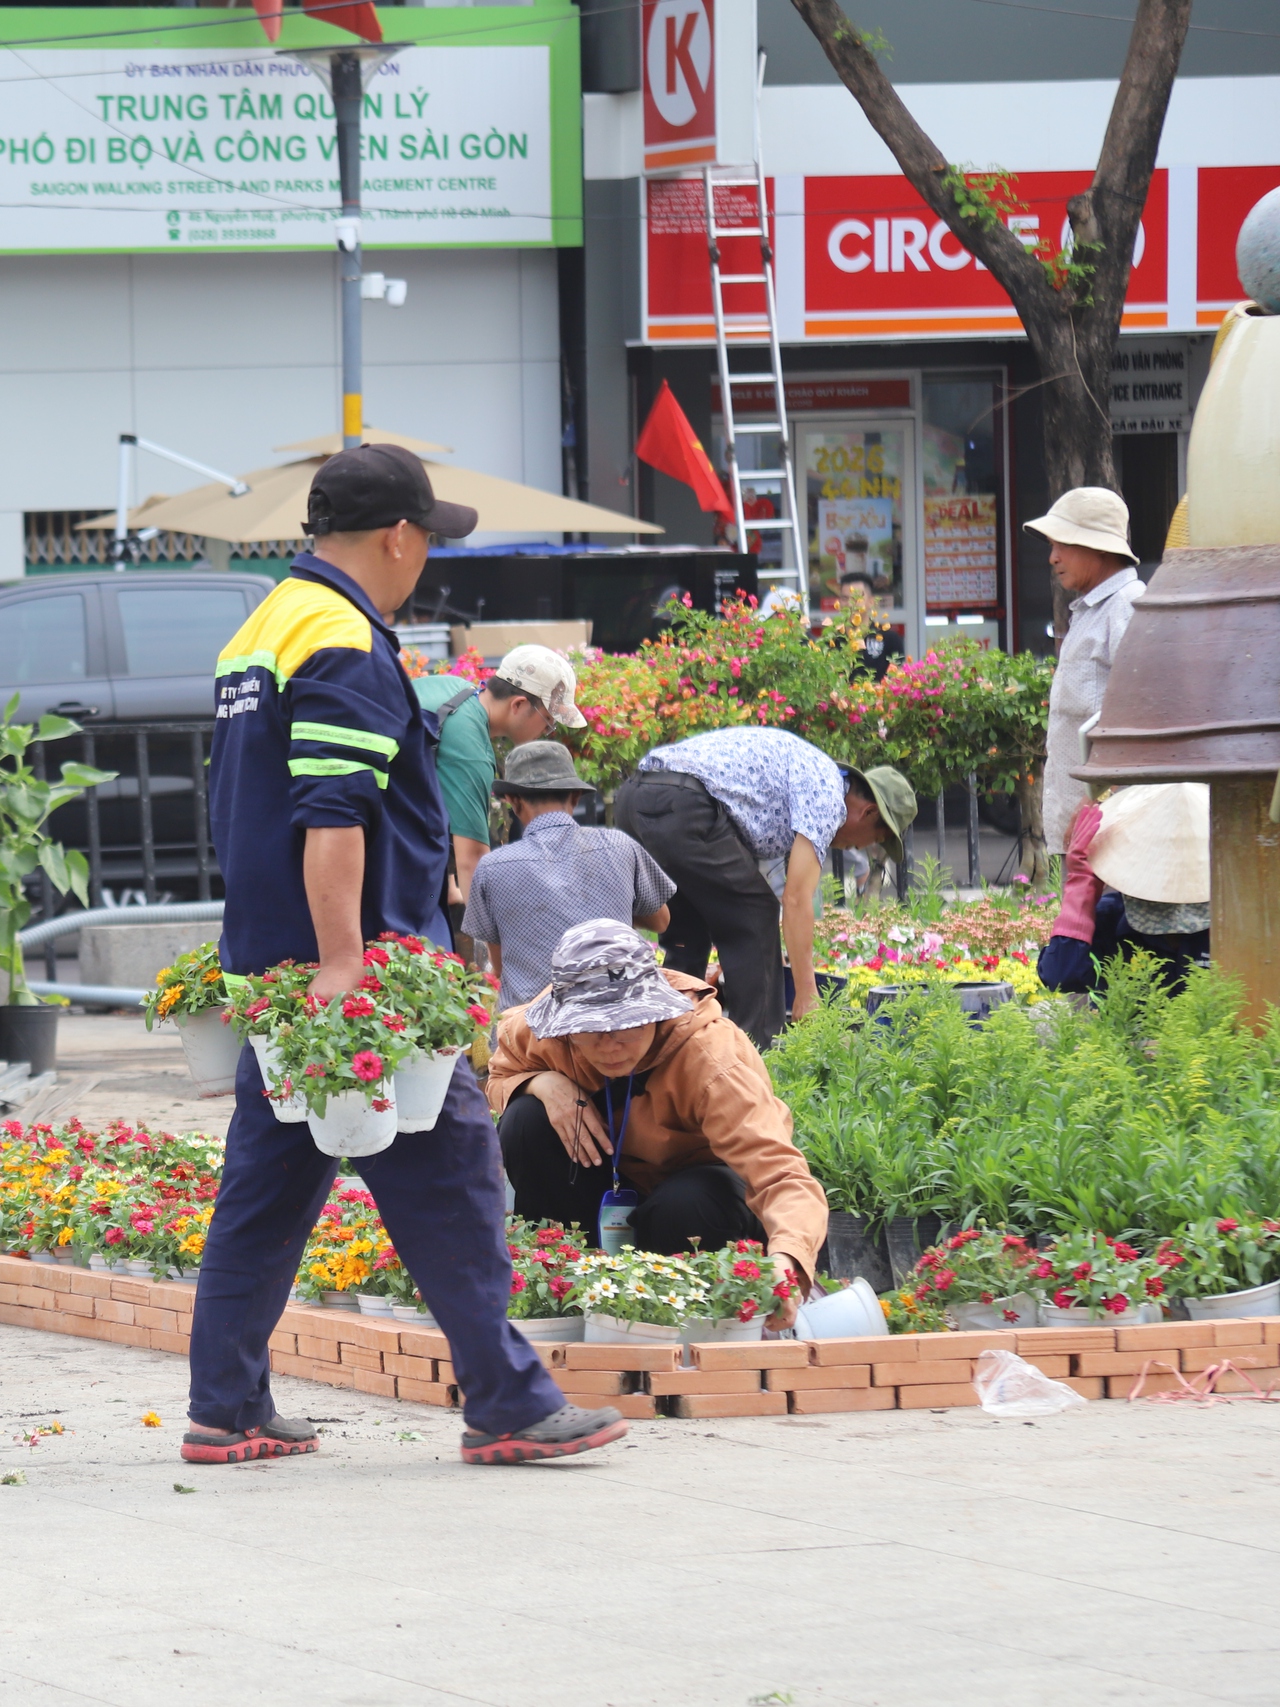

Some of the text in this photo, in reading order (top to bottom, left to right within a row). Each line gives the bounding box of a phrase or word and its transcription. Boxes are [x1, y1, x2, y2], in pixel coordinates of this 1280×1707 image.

[151, 65, 181, 77] BAN
[234, 61, 264, 76] DÂN
[97, 86, 430, 121] TRUNG TÂM QUN LÝ
[65, 137, 95, 163] ĐI
[108, 134, 153, 170] BỘ
[162, 130, 204, 162] VÀ
[215, 129, 307, 162] CÔNG
[400, 127, 448, 159] SÀI
[460, 126, 528, 159] GÒN
[30, 177, 497, 196] SAIGON WALKING STREETS AND PARKS MAGEMENT CENTRE
[1132, 382, 1182, 401] ENTRANCE
[938, 501, 981, 520] DEAL
